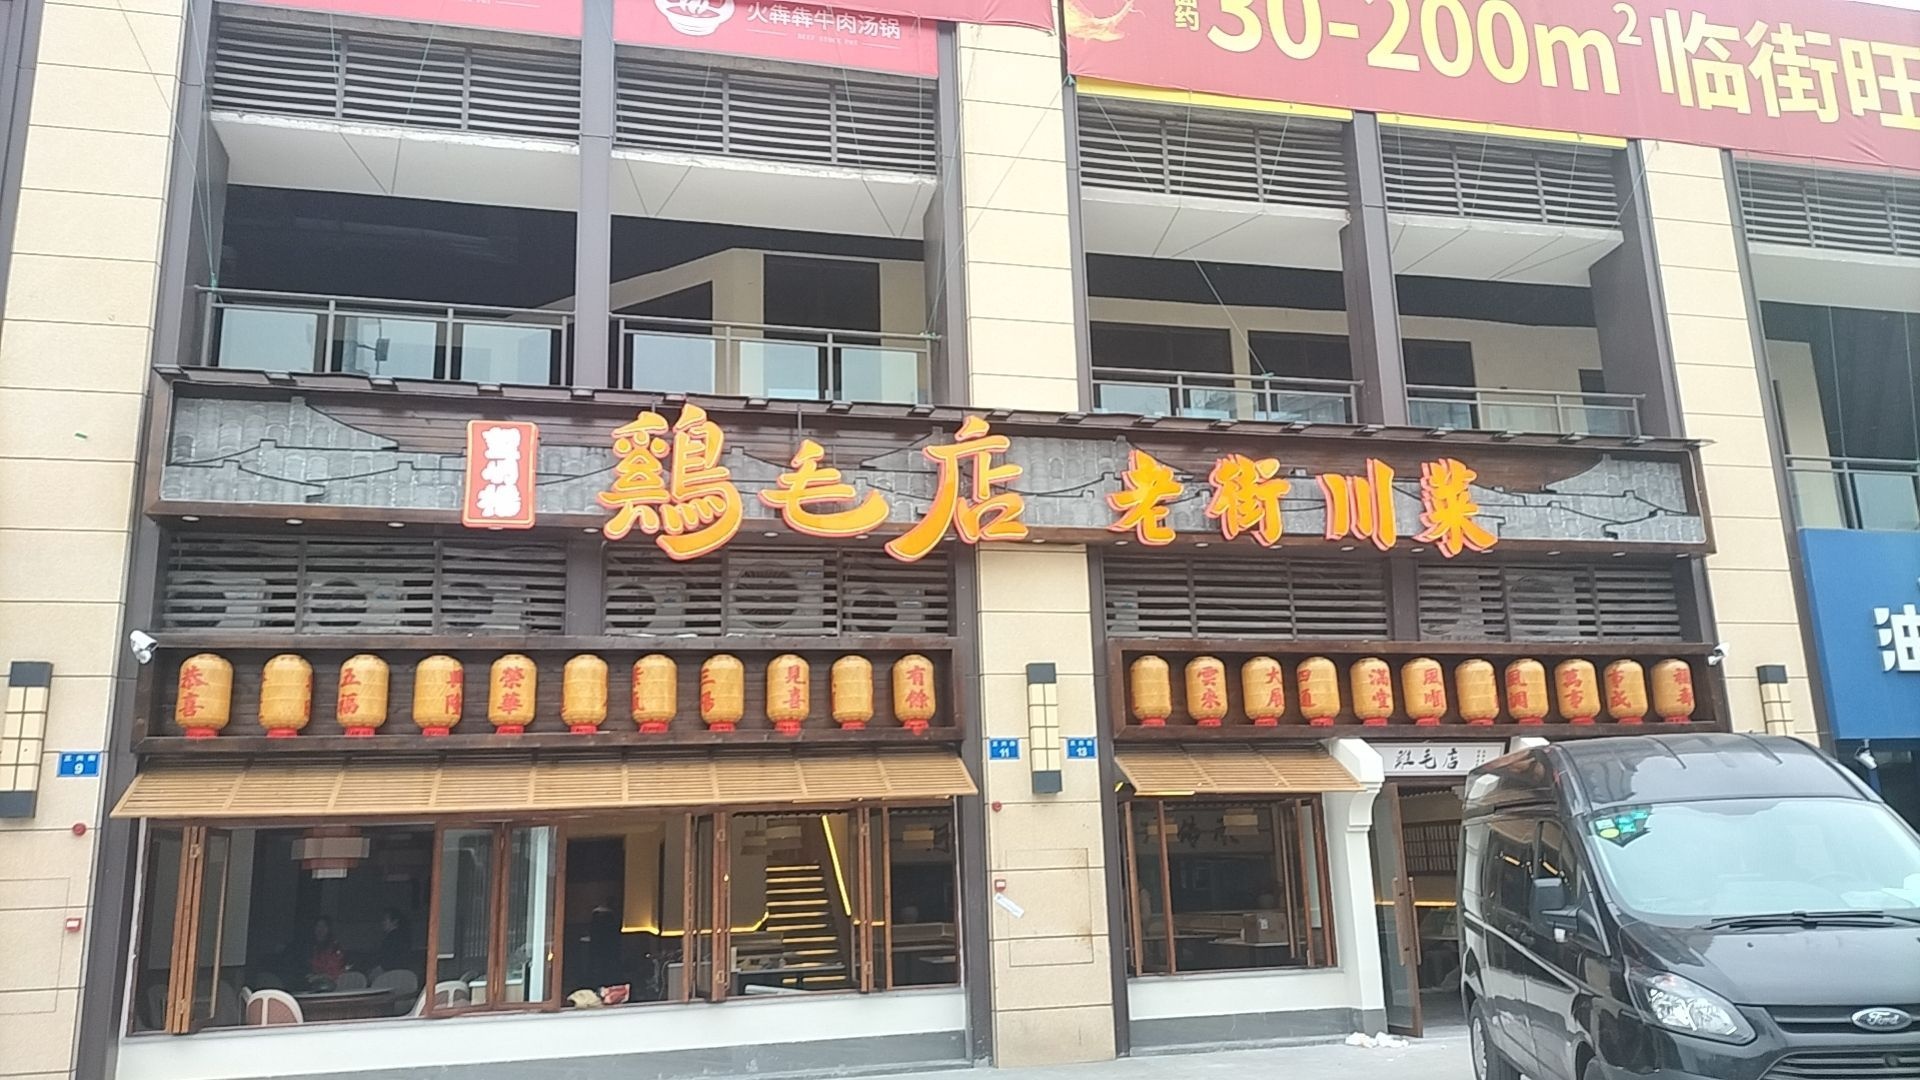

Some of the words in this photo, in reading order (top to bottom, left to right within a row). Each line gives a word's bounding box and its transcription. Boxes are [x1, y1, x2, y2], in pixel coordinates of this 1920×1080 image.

[1107, 449, 1499, 559] 老街川菜
[178, 665, 210, 718] 恭喜
[497, 666, 525, 715] 榮華
[74, 762, 85, 775] 9
[1866, 1011, 1901, 1028] Ford
